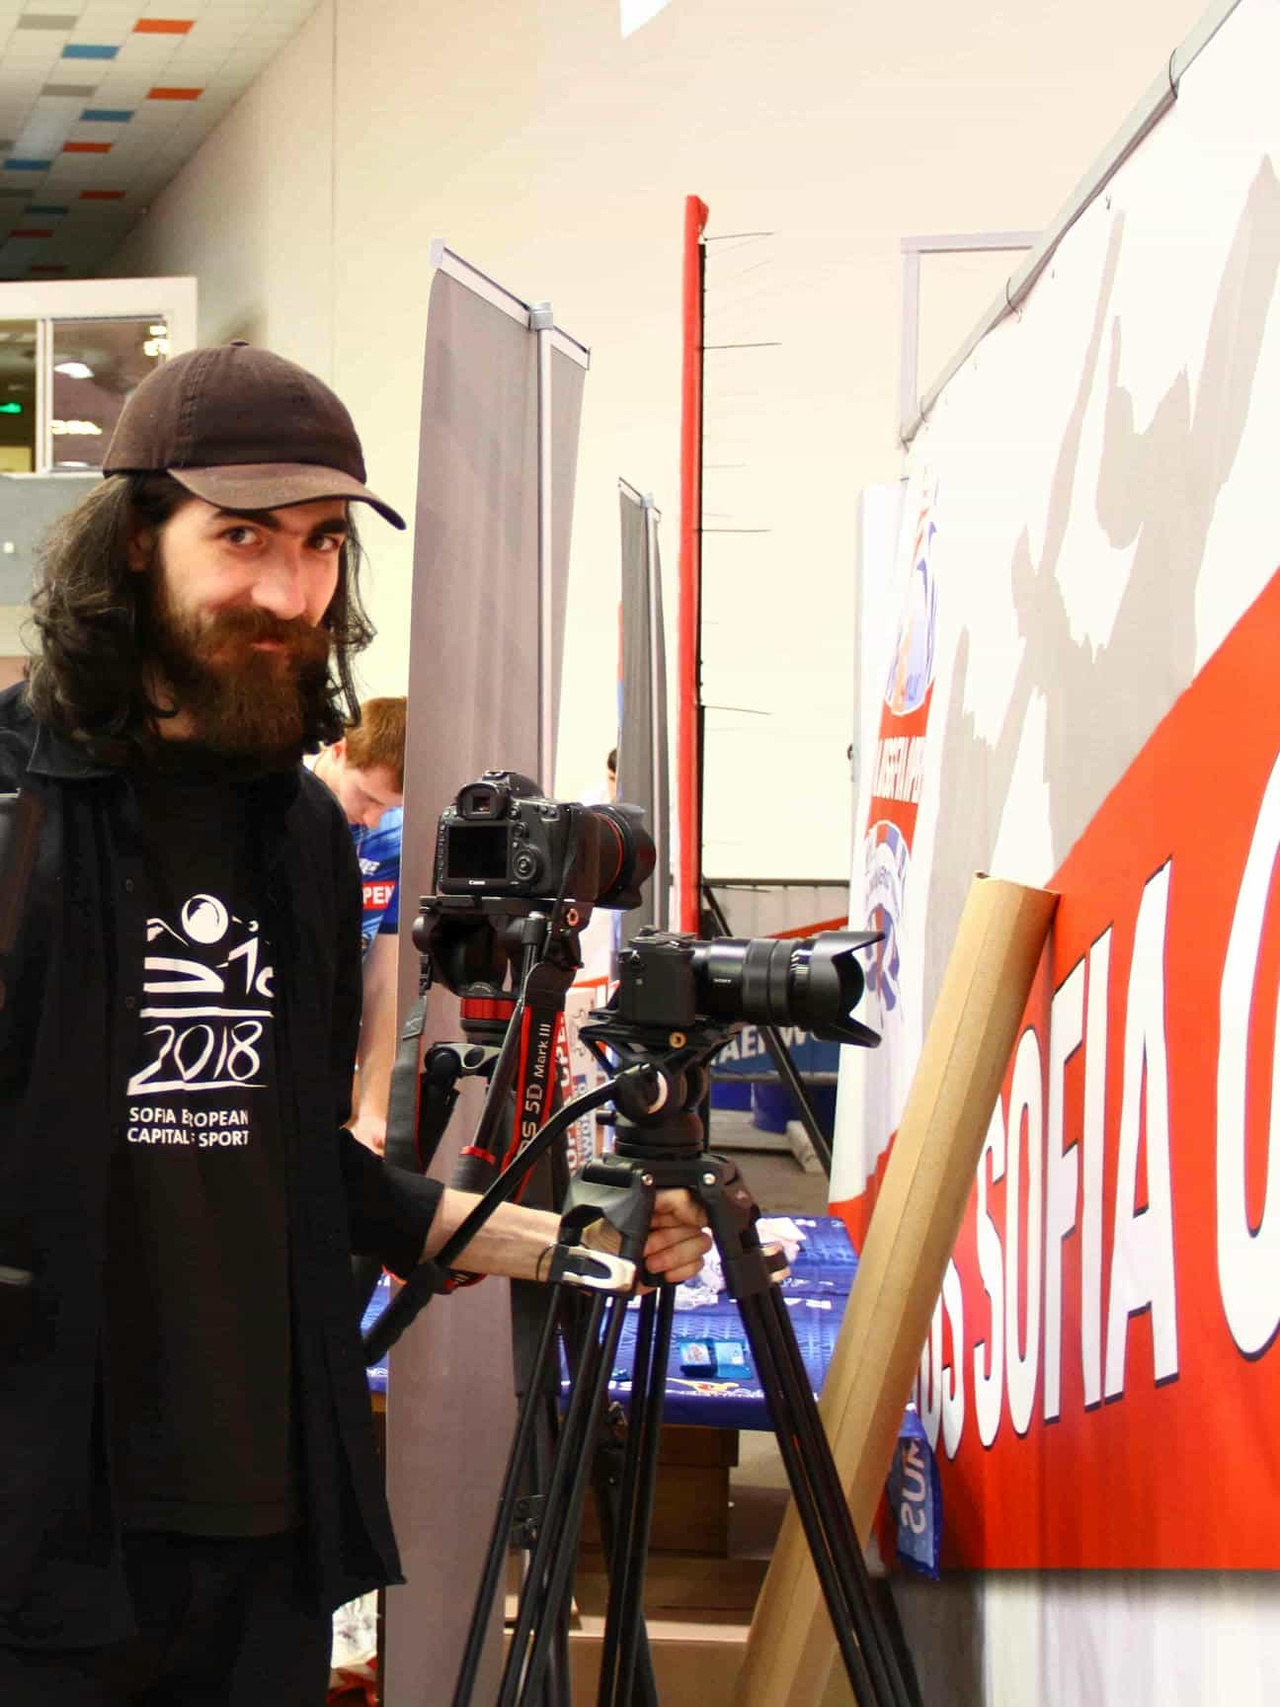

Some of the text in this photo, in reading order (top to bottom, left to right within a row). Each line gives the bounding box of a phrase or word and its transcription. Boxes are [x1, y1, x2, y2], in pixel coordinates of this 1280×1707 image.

[363, 885, 395, 905] PEN
[539, 1023, 551, 1037] III
[127, 1020, 268, 1096] 2018
[534, 1041, 550, 1079] Mark
[525, 1083, 543, 1114] 5D
[129, 1106, 176, 1123] SOFIA
[127, 1128, 190, 1144] CAPITAL
[199, 1130, 249, 1147] SPORT
[973, 854, 1180, 1450] SOFIA
